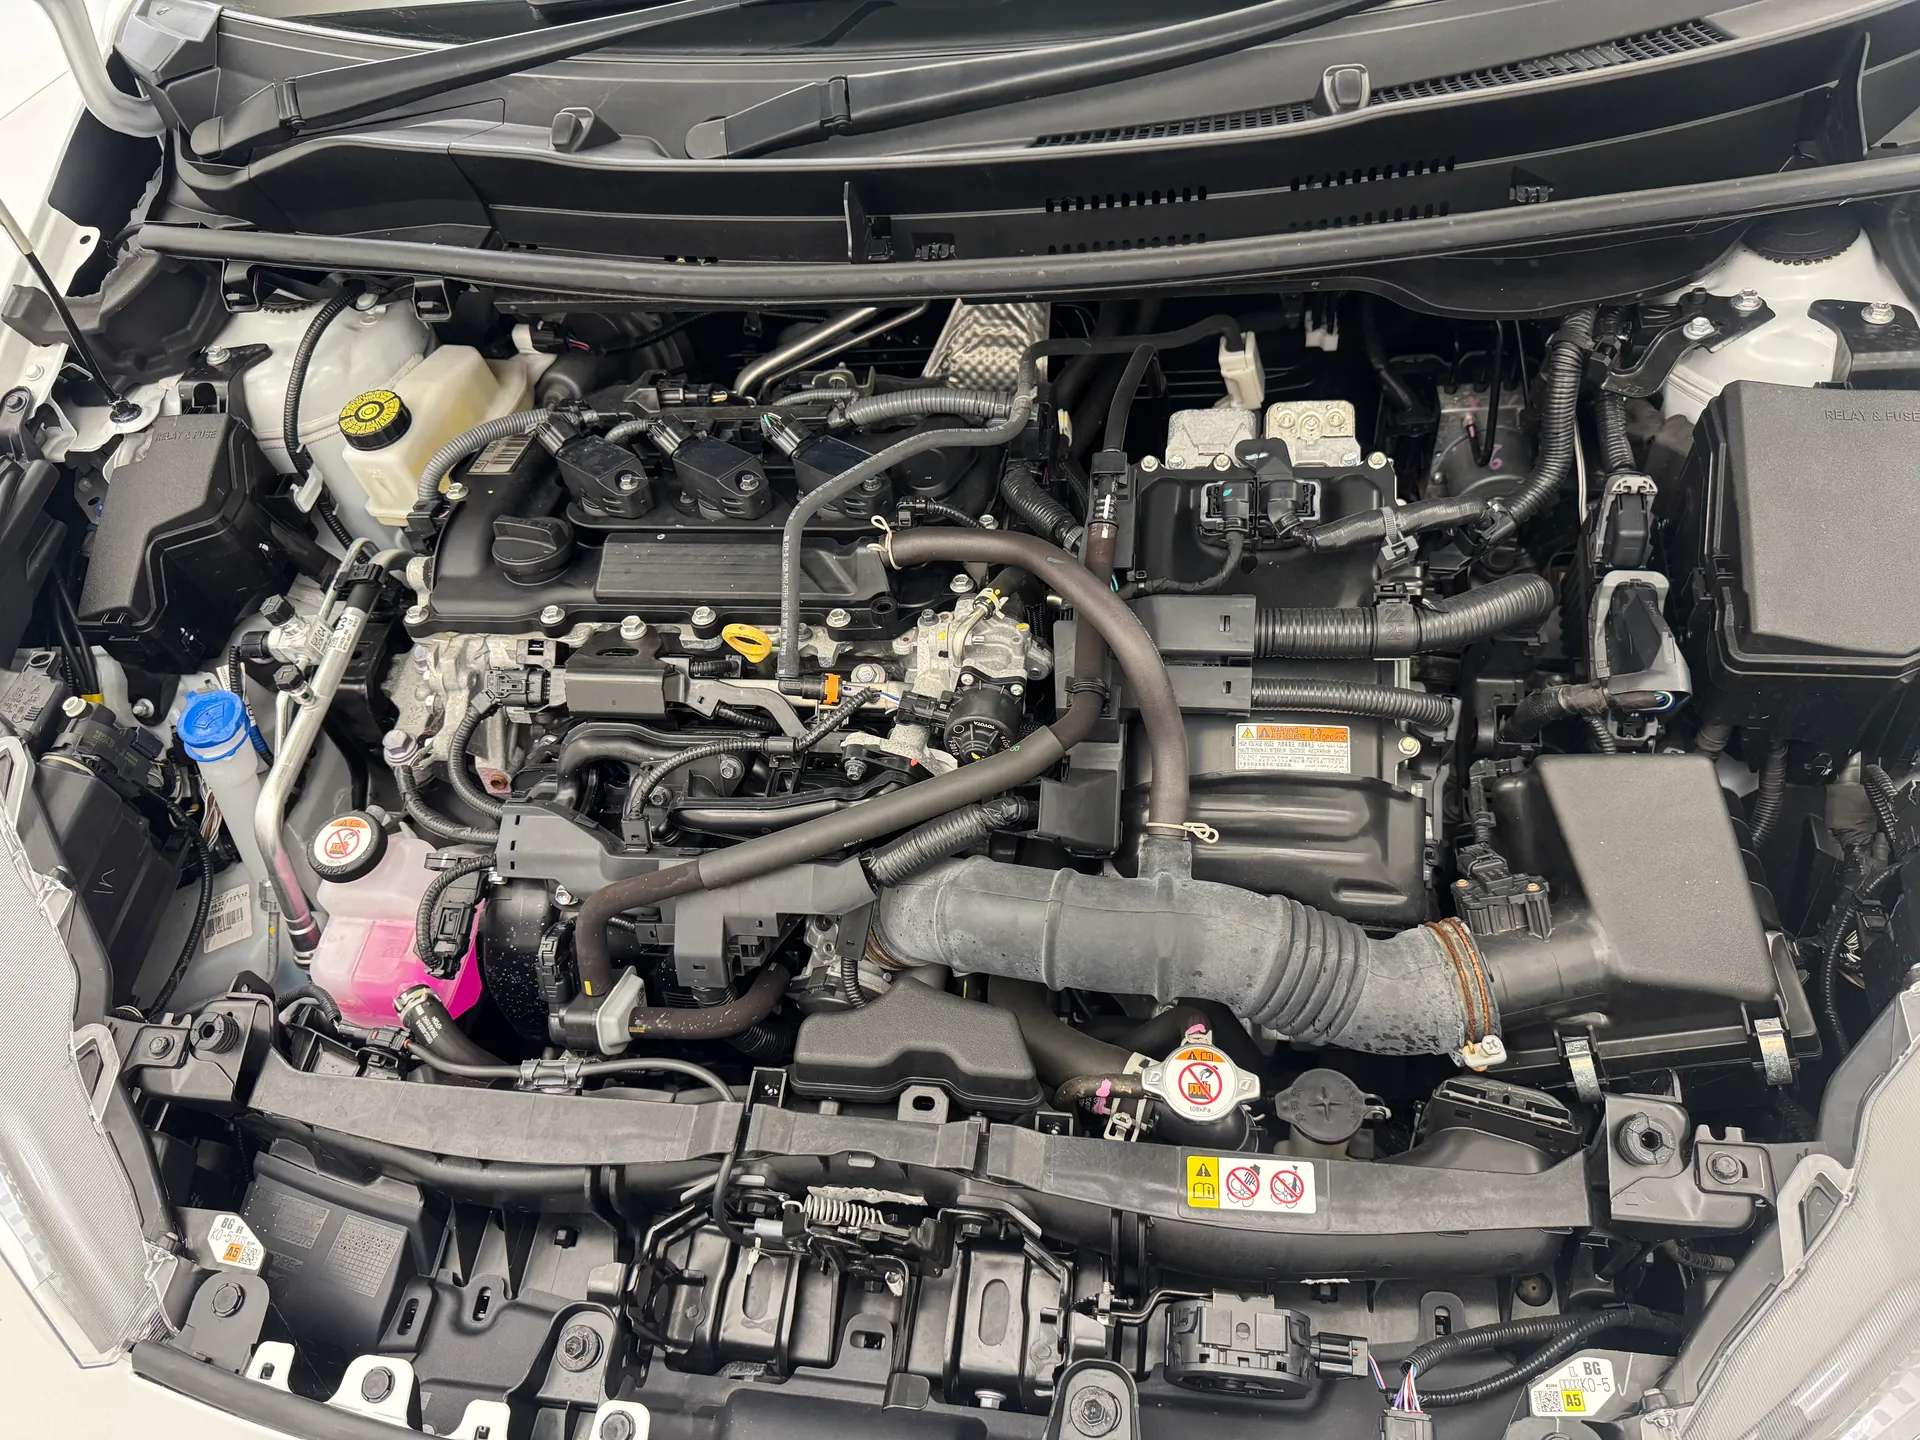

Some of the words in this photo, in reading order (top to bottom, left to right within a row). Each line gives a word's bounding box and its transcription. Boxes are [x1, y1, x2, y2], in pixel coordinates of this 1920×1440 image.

[1824, 408, 1865, 422] RELAY
[1872, 408, 1881, 422] &
[1885, 408, 1920, 422] FUSE
[973, 720, 996, 730] TOYOTA
[220, 1216, 236, 1230] BG
[225, 1245, 241, 1258] A5
[1582, 1361, 1603, 1376] BG
[1565, 1393, 1583, 1408] A5
